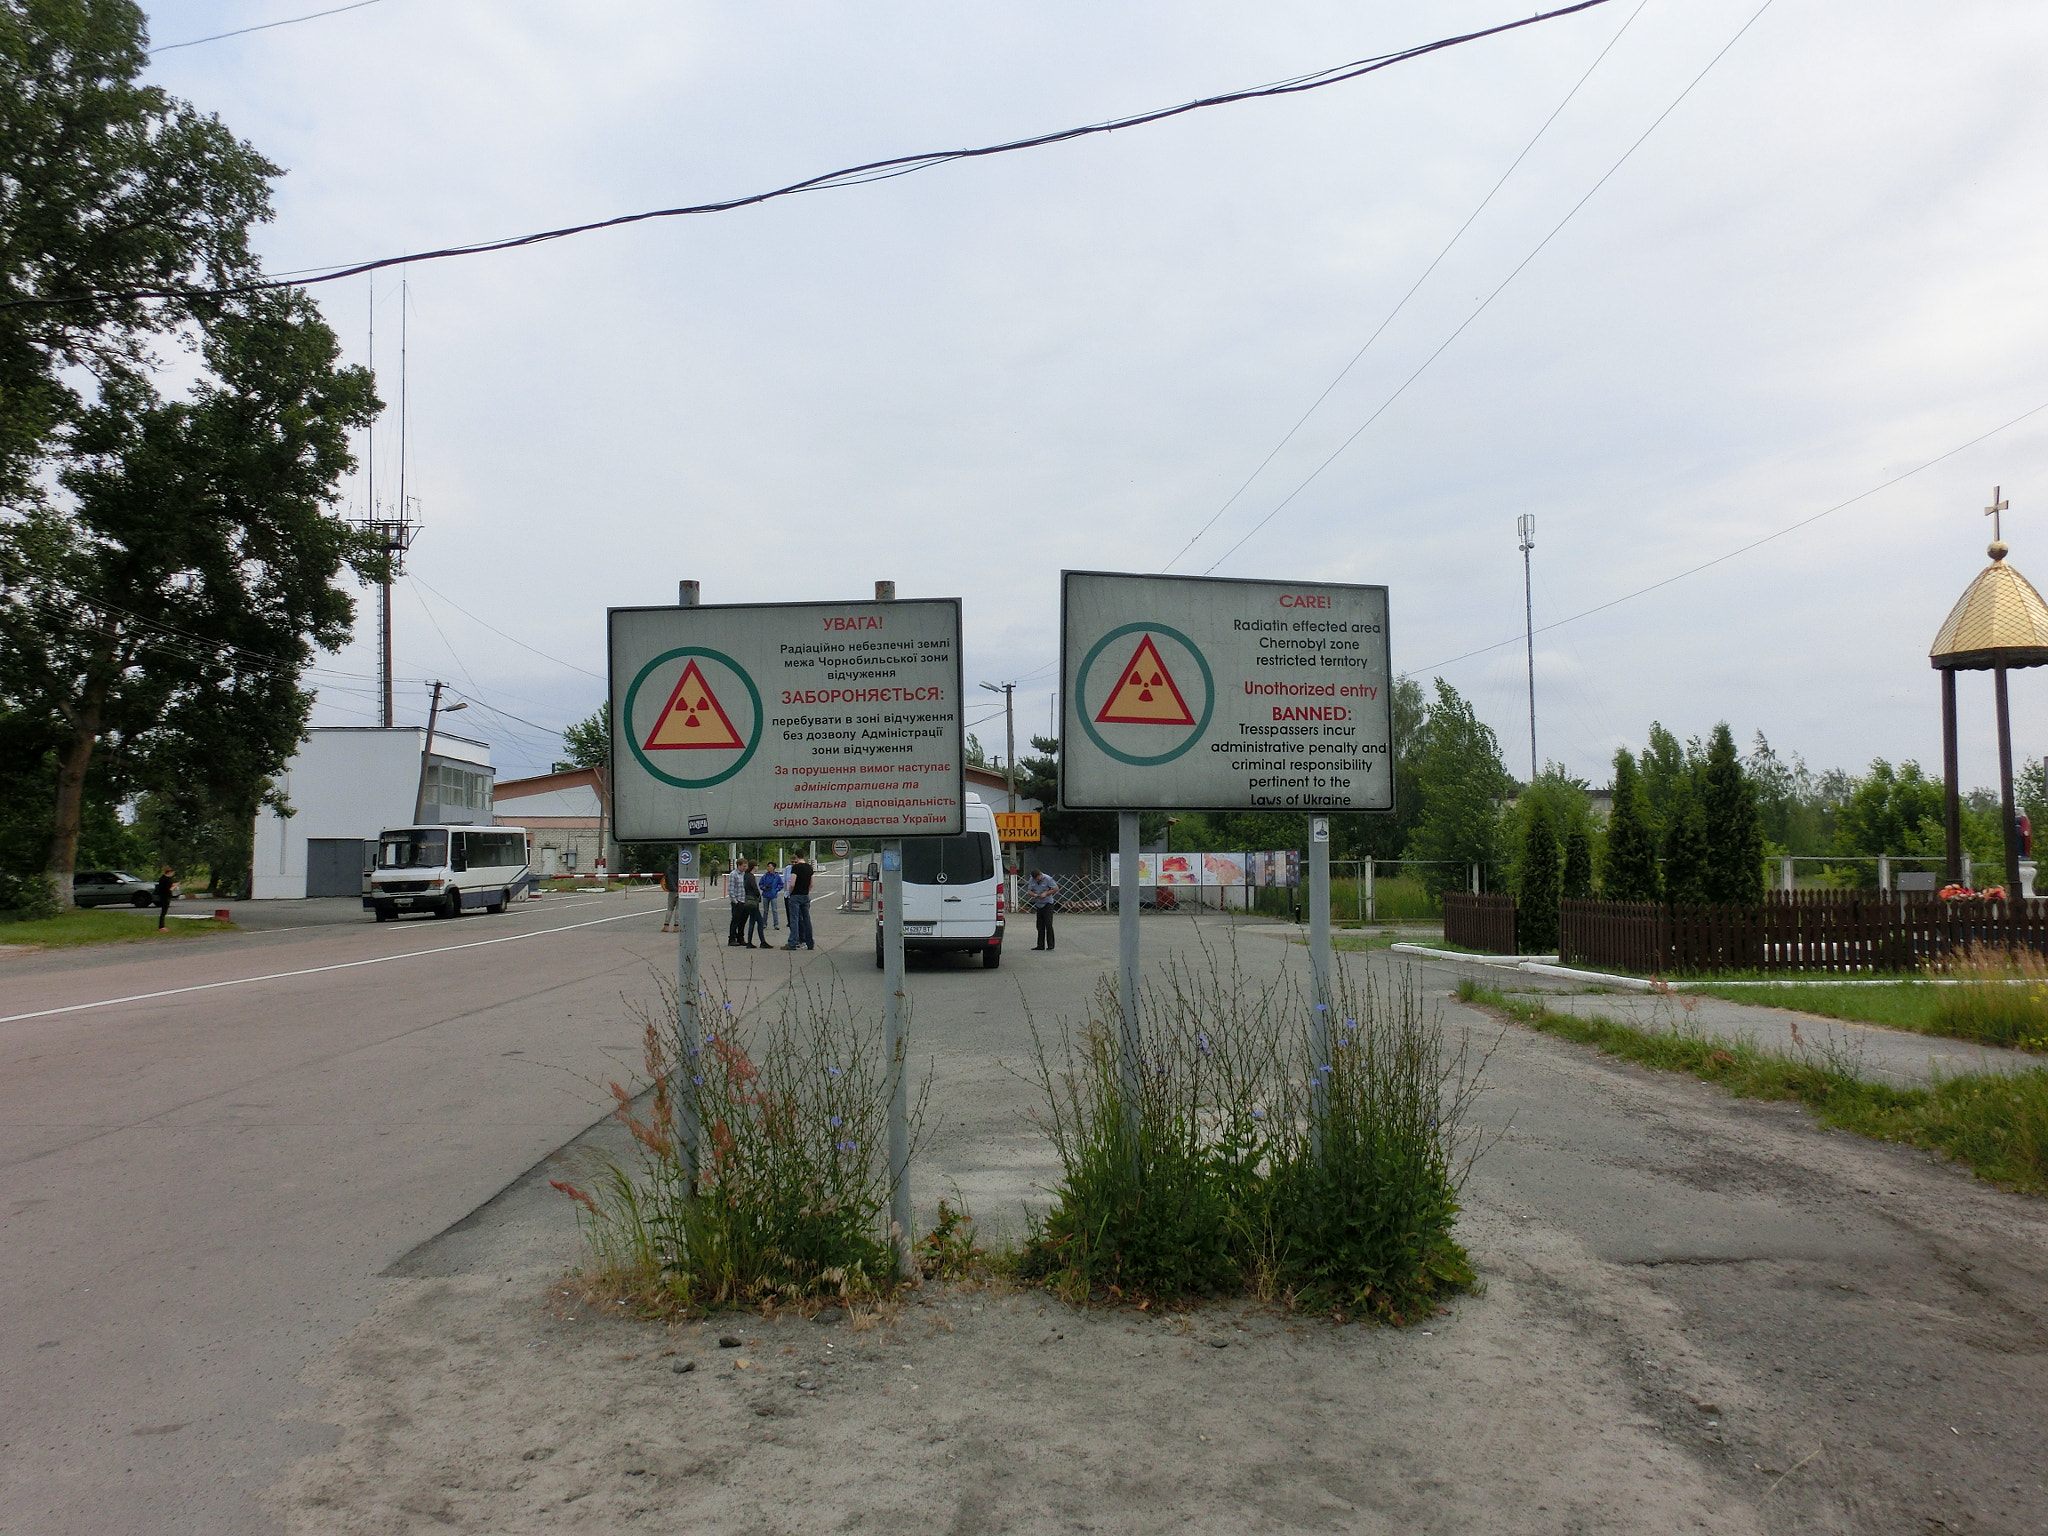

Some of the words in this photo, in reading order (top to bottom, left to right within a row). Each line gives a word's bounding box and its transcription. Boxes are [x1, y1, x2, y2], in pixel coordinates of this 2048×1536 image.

[1279, 594, 1331, 609] CARE!
[823, 616, 883, 631] УВАГА!
[1233, 619, 1288, 631] Radiatin
[1292, 620, 1347, 632] effected
[1351, 623, 1381, 633] area
[780, 643, 845, 655] Радіаційно
[848, 639, 914, 651] небезпечні
[917, 638, 950, 649] землі
[1259, 637, 1326, 651] Chernobyl
[1330, 640, 1360, 650] zone
[784, 658, 815, 668] межа
[818, 653, 917, 668] Чорнобильської
[920, 654, 948, 663] зони
[1256, 655, 1316, 666] restricted
[1320, 655, 1368, 669] territory
[827, 669, 896, 681] відчуження
[781, 687, 944, 704] ЗАБОРОНЯЄТЬСЯ:
[1244, 681, 1335, 696] Unothorized
[1340, 683, 1377, 700] entry
[772, 716, 842, 727] перебувати
[846, 716, 852, 724] в
[856, 713, 880, 724] зоні
[884, 712, 954, 724] відчуження
[1272, 706, 1352, 721] BANNED:
[783, 731, 803, 740] без
[806, 730, 856, 741] дозволу
[861, 726, 943, 740] Адміністрації
[1239, 723, 1318, 737] Tresspassers
[1323, 724, 1356, 736] incur
[812, 745, 840, 755] зони
[844, 744, 913, 756] відчуження
[1211, 741, 1304, 753] administrative
[1309, 743, 1357, 755] penalty
[1362, 743, 1387, 754] and
[774, 765, 789, 775] За
[792, 764, 856, 777] порушення
[859, 764, 895, 773] вимог
[898, 763, 950, 774] наступає
[1232, 758, 1286, 770] criminal
[1290, 760, 1372, 772] responsibility
[794, 781, 899, 793] адміністративна
[902, 781, 919, 789] та
[1249, 776, 1309, 789] pertinent
[1313, 776, 1326, 787] to
[1330, 777, 1351, 787] the
[773, 800, 847, 811] кримінальна
[855, 796, 956, 809] відповідальність
[1251, 793, 1282, 806] Laws
[1286, 794, 1299, 806] of
[1303, 795, 1351, 806] Ukraine
[773, 817, 809, 828] згідно
[812, 814, 899, 826] Законодавства
[902, 814, 947, 824] України
[998, 828, 1037, 837] ТЯТКИ
